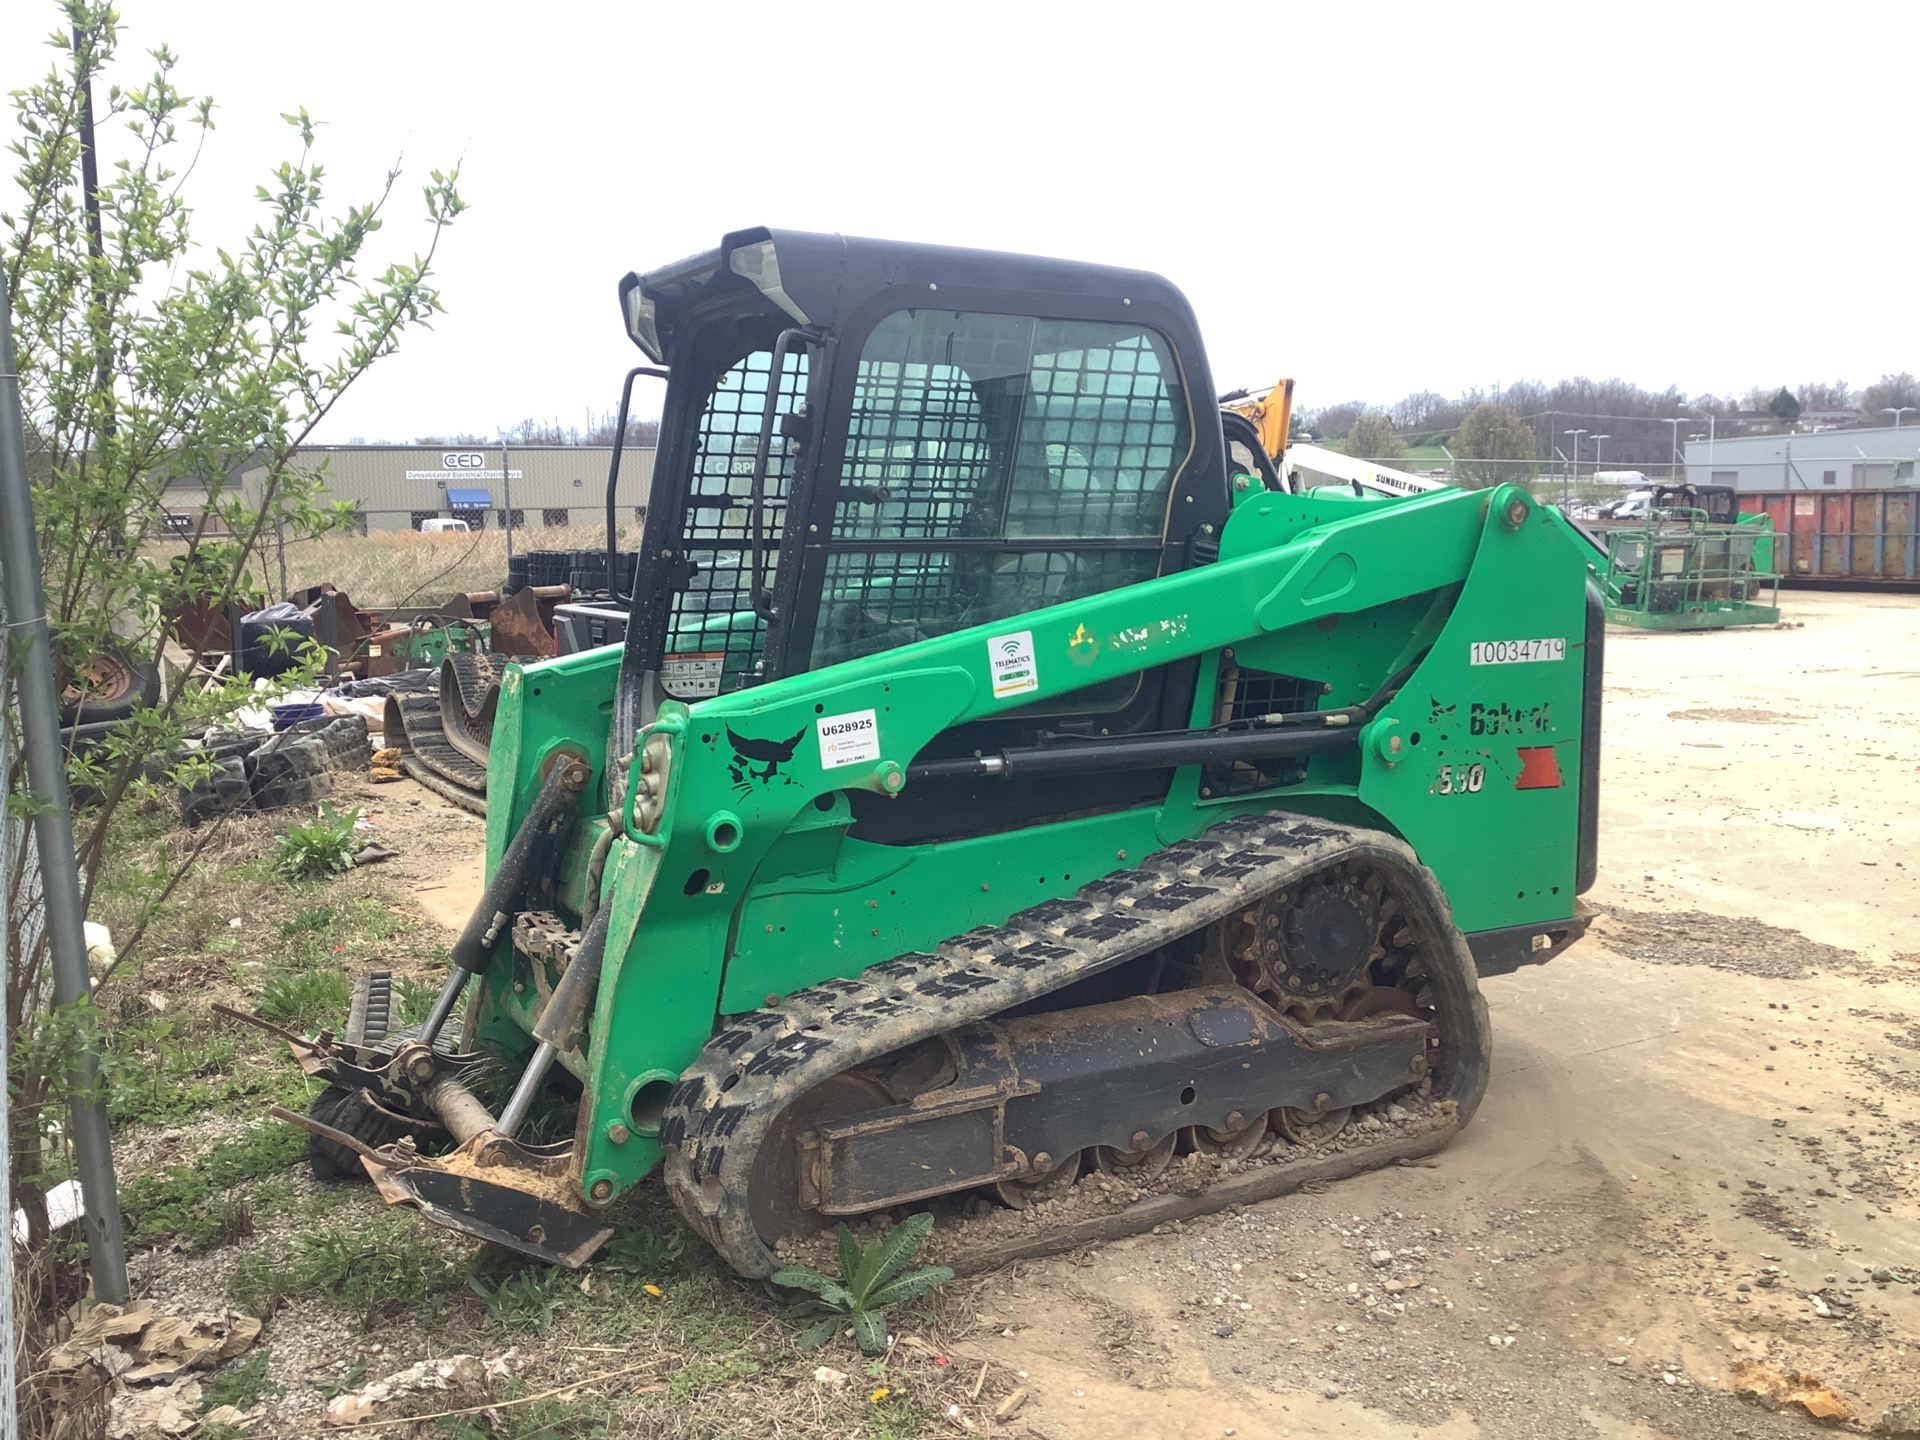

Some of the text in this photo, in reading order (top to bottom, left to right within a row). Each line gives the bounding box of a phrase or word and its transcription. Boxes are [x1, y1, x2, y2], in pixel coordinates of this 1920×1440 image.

[444, 454, 483, 467] CED
[1375, 474, 1430, 494] SUNBELT RENT
[1473, 638, 1565, 664] 10034719
[995, 655, 1031, 668] TELEMATICS
[822, 719, 873, 736] U628925
